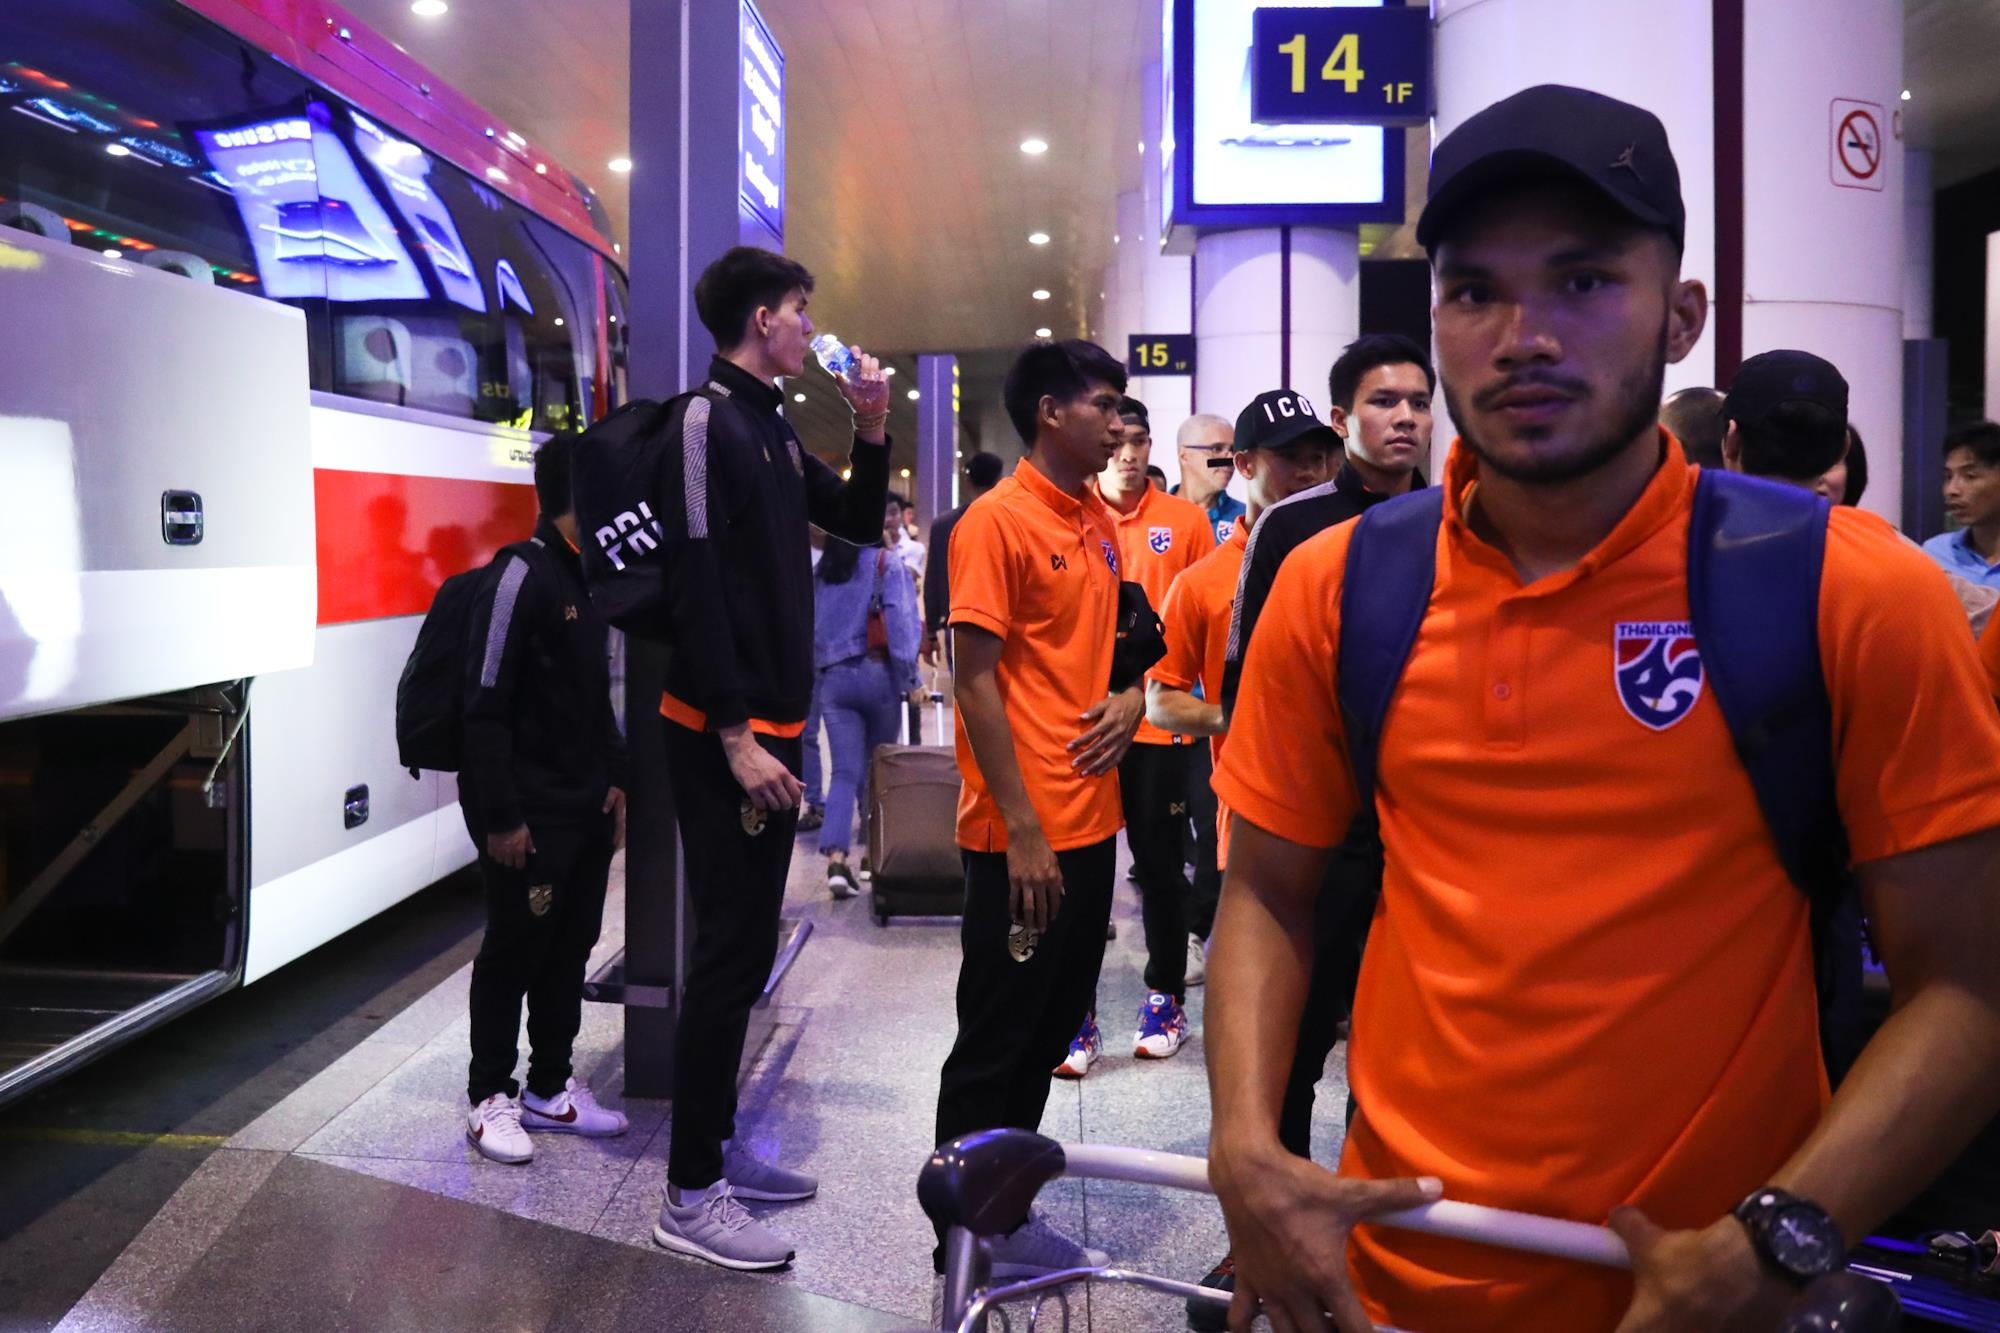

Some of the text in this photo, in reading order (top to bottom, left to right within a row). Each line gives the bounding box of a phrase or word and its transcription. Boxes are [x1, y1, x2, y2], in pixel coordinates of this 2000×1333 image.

[1278, 33, 1413, 103] 14 1F
[1135, 343, 1168, 367] 15
